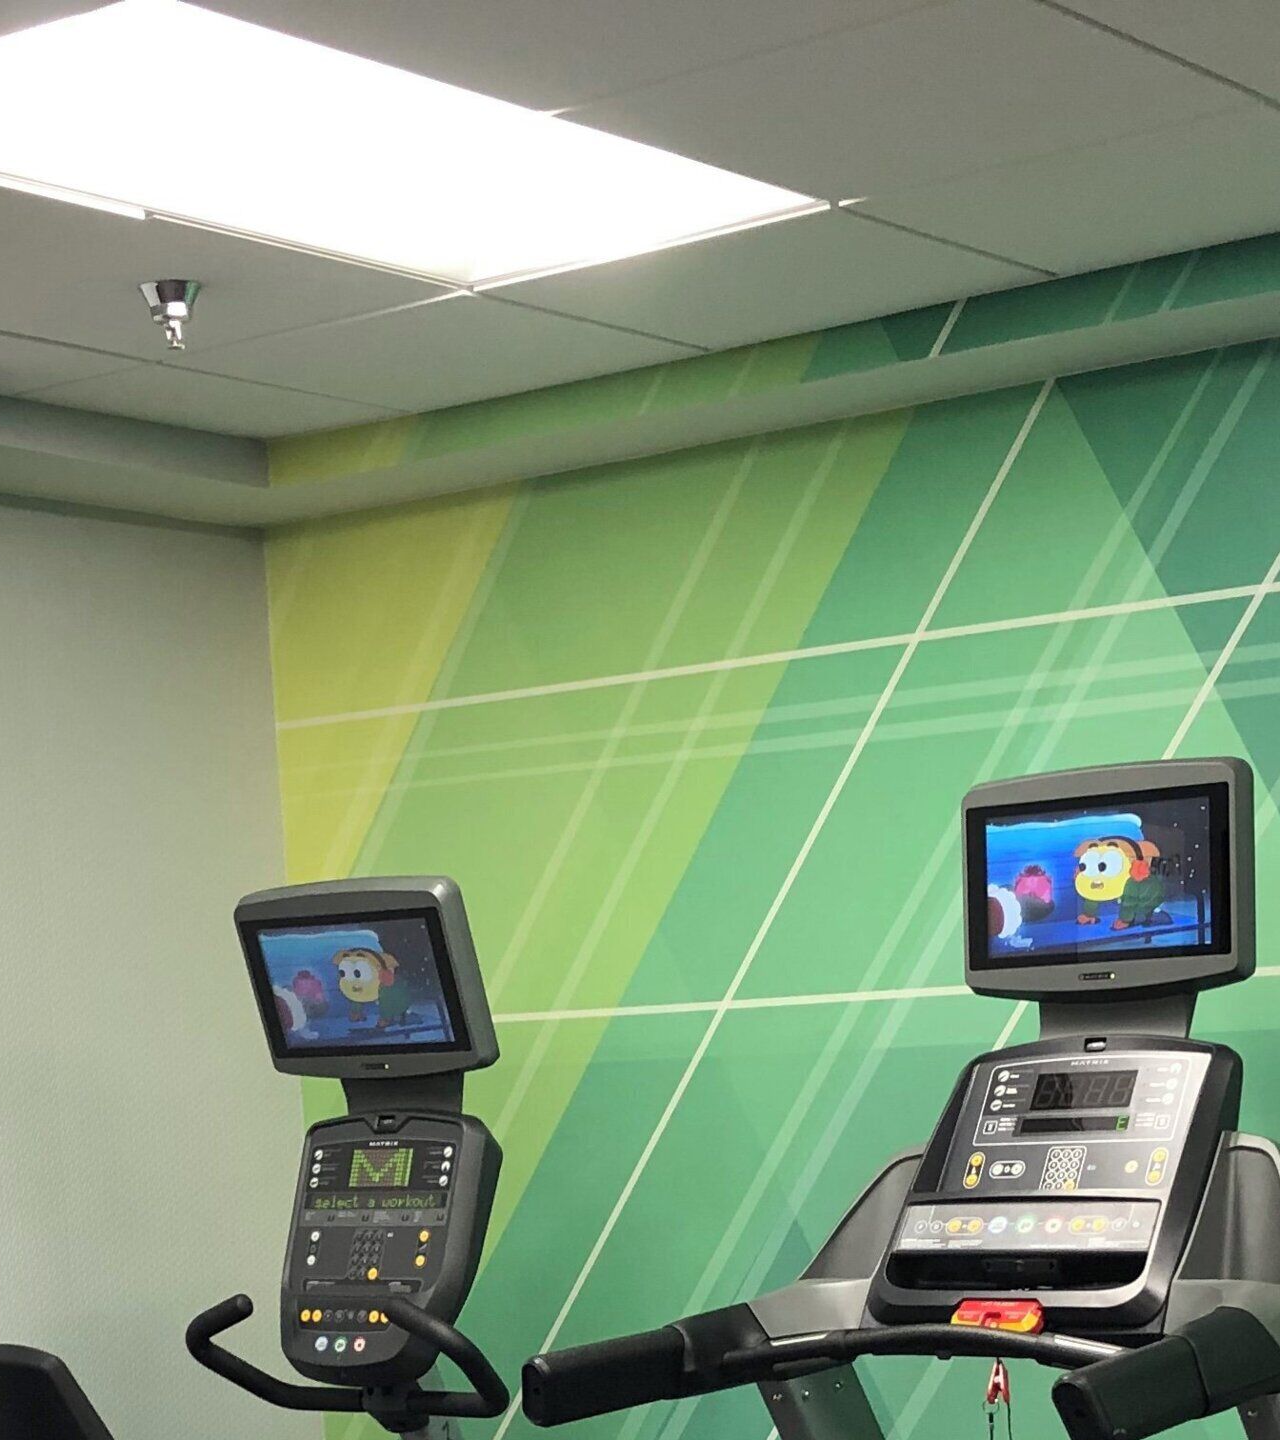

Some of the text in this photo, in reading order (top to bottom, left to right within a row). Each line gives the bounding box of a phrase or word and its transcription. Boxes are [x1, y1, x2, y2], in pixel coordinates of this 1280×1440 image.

[314, 1194, 437, 1208] select a workout
